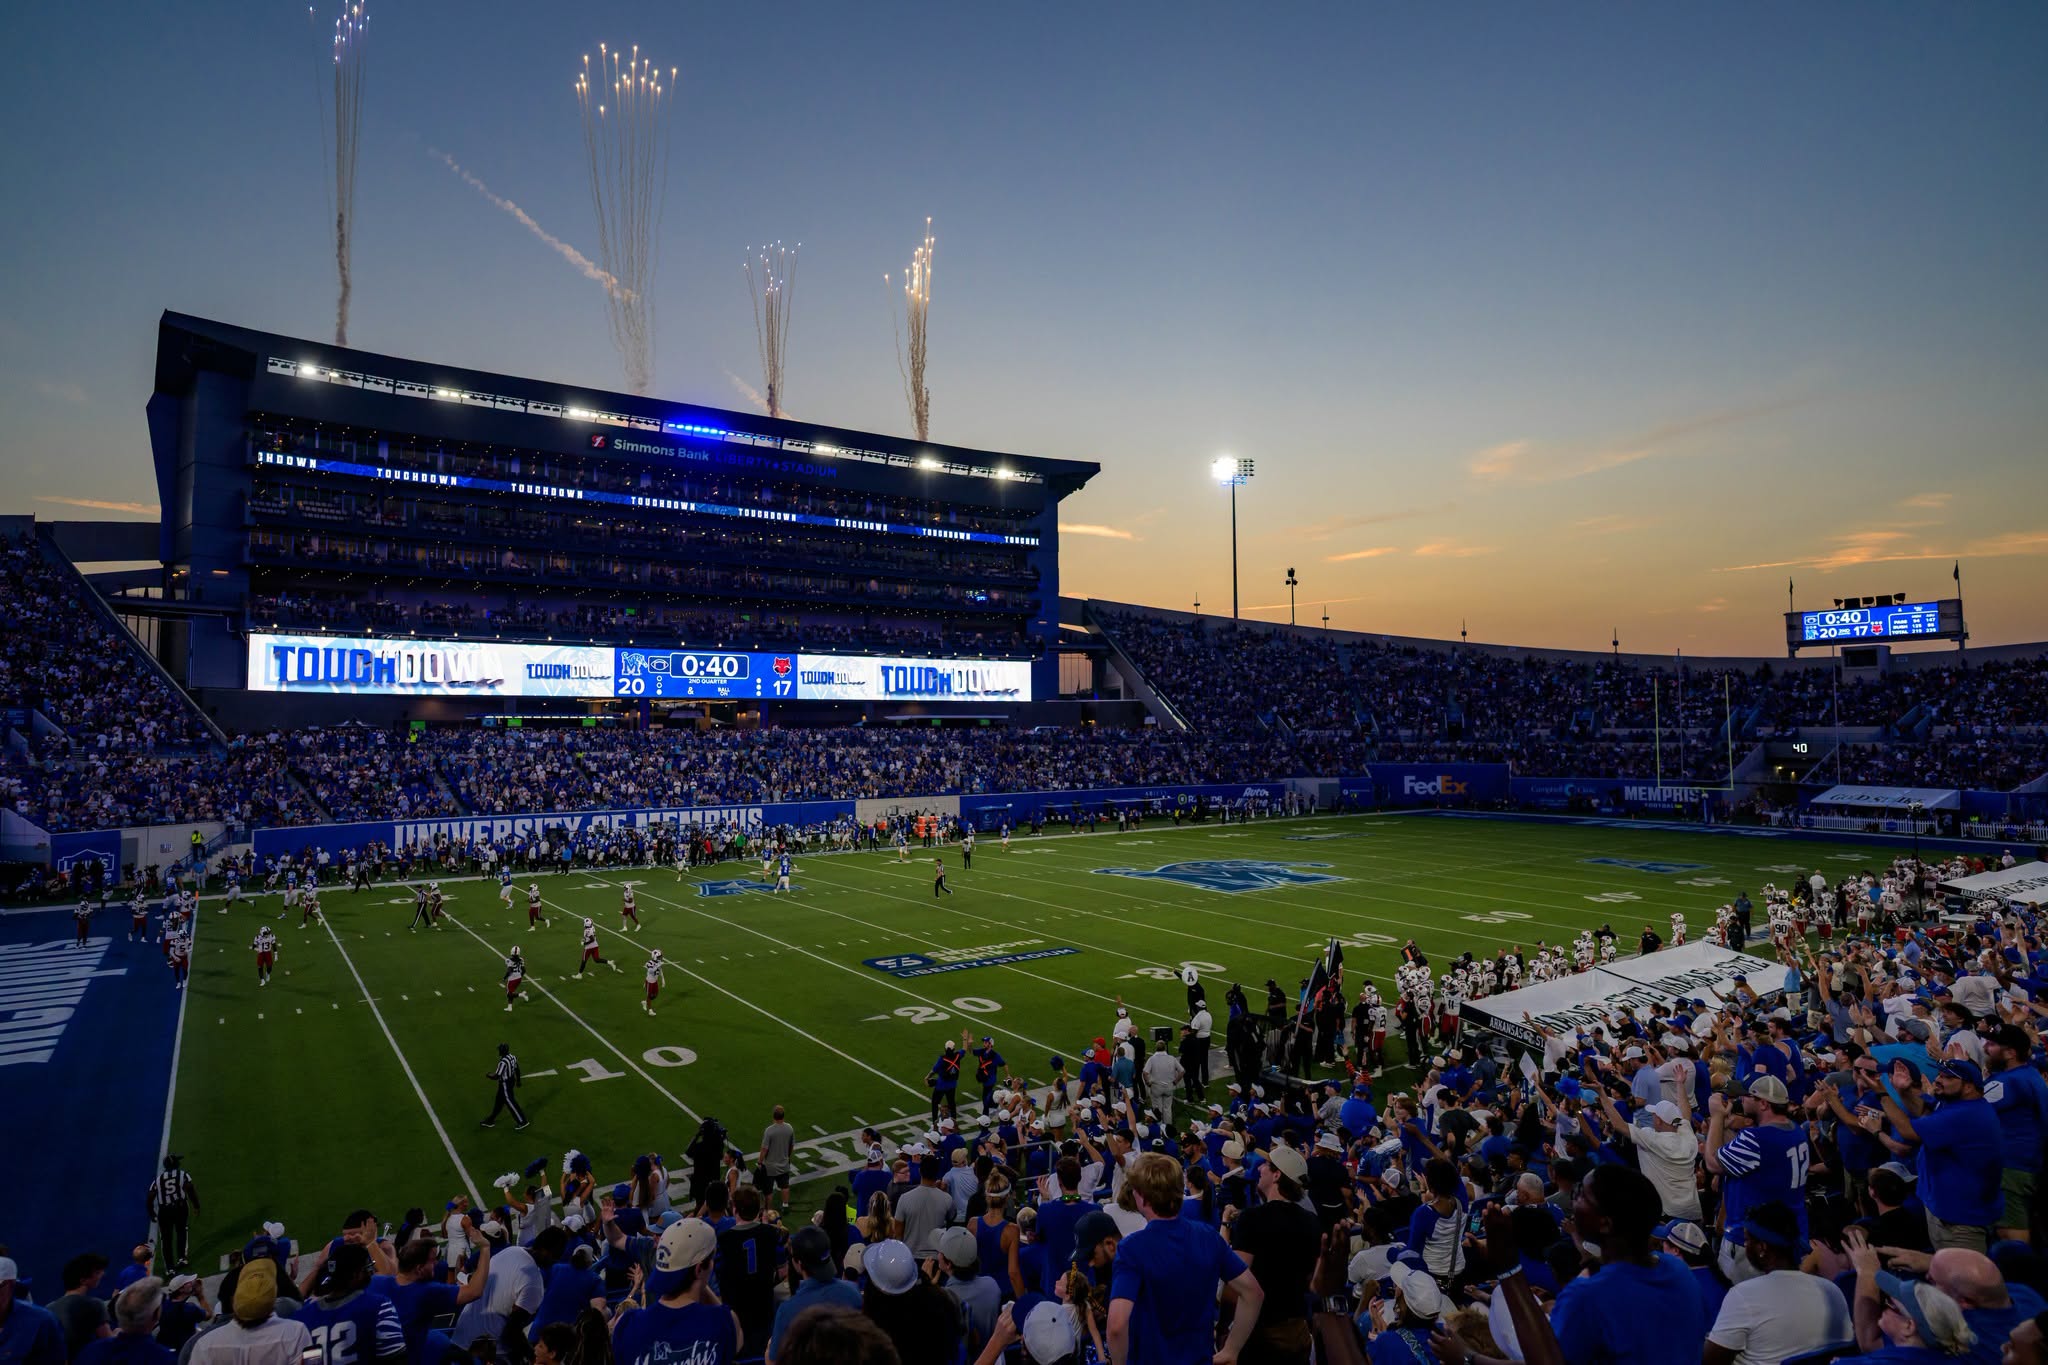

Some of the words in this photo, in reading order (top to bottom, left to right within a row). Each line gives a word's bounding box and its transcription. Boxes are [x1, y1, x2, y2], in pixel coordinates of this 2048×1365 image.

[613, 438, 675, 457] Simmons
[677, 446, 710, 462] Bank
[377, 468, 457, 485] TOUCHDOWN
[511, 483, 583, 499] TOUCHDOWN
[631, 496, 696, 511] TOUCHDOWN
[738, 508, 797, 522] TOUCHDOWN
[835, 519, 888, 532] TOUCHDOWN
[1825, 611, 1861, 625] 0:40
[1819, 628, 1838, 638] 20
[1853, 626, 1868, 636] 17
[272, 645, 505, 688] TOUCHDOWN
[681, 655, 739, 677] 0:40
[617, 678, 646, 695] 20
[772, 680, 792, 696] 17
[1792, 743, 1808, 754] 40
[1403, 774, 1468, 796] FedEx
[1624, 785, 1701, 803] MEMPHIS
[1883, 895, 1894, 904] 79
[1459, 911, 1534, 924] 50
[1774, 924, 1788, 934] 90
[897, 961, 980, 978] LIBERTY
[993, 947, 1076, 964] STADIUM
[893, 996, 1003, 1025] 20
[1489, 1016, 1524, 1040] ARKANSAS
[564, 1045, 698, 1084] 10
[1785, 1142, 1810, 1190] 12
[165, 1178, 176, 1194] S
[741, 1237, 759, 1275] 1
[311, 1320, 358, 1365] 12
